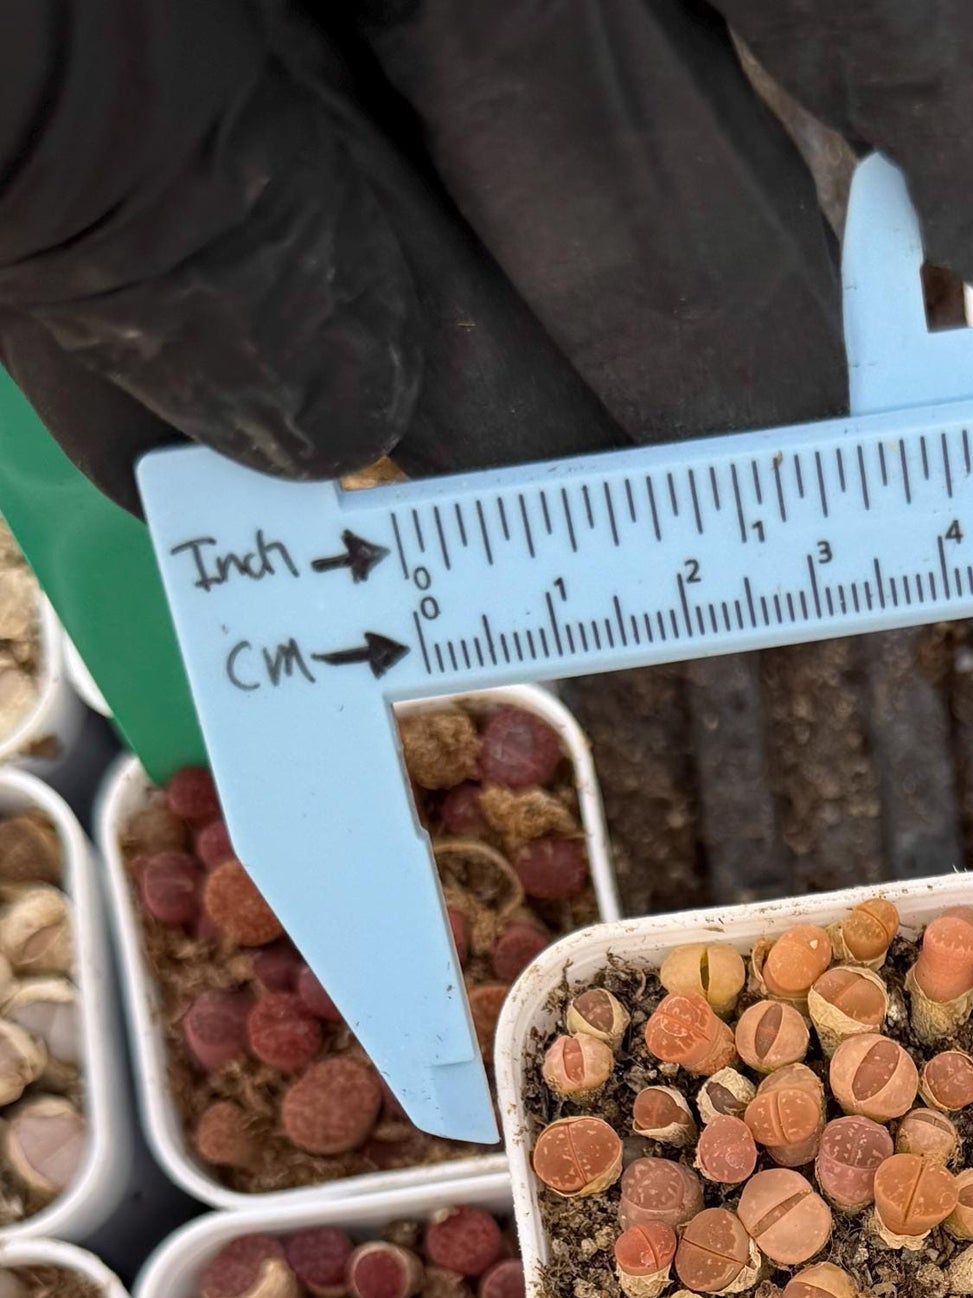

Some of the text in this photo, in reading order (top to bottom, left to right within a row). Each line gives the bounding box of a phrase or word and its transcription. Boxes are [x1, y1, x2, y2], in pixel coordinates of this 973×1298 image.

[171, 529, 300, 592] Inch
[413, 566, 432, 590] 0
[752, 521, 765, 542] 1
[420, 596, 440, 620] 0
[554, 577, 567, 601] 1
[685, 560, 701, 582] 2
[817, 541, 833, 564] 3
[945, 520, 963, 543] 4
